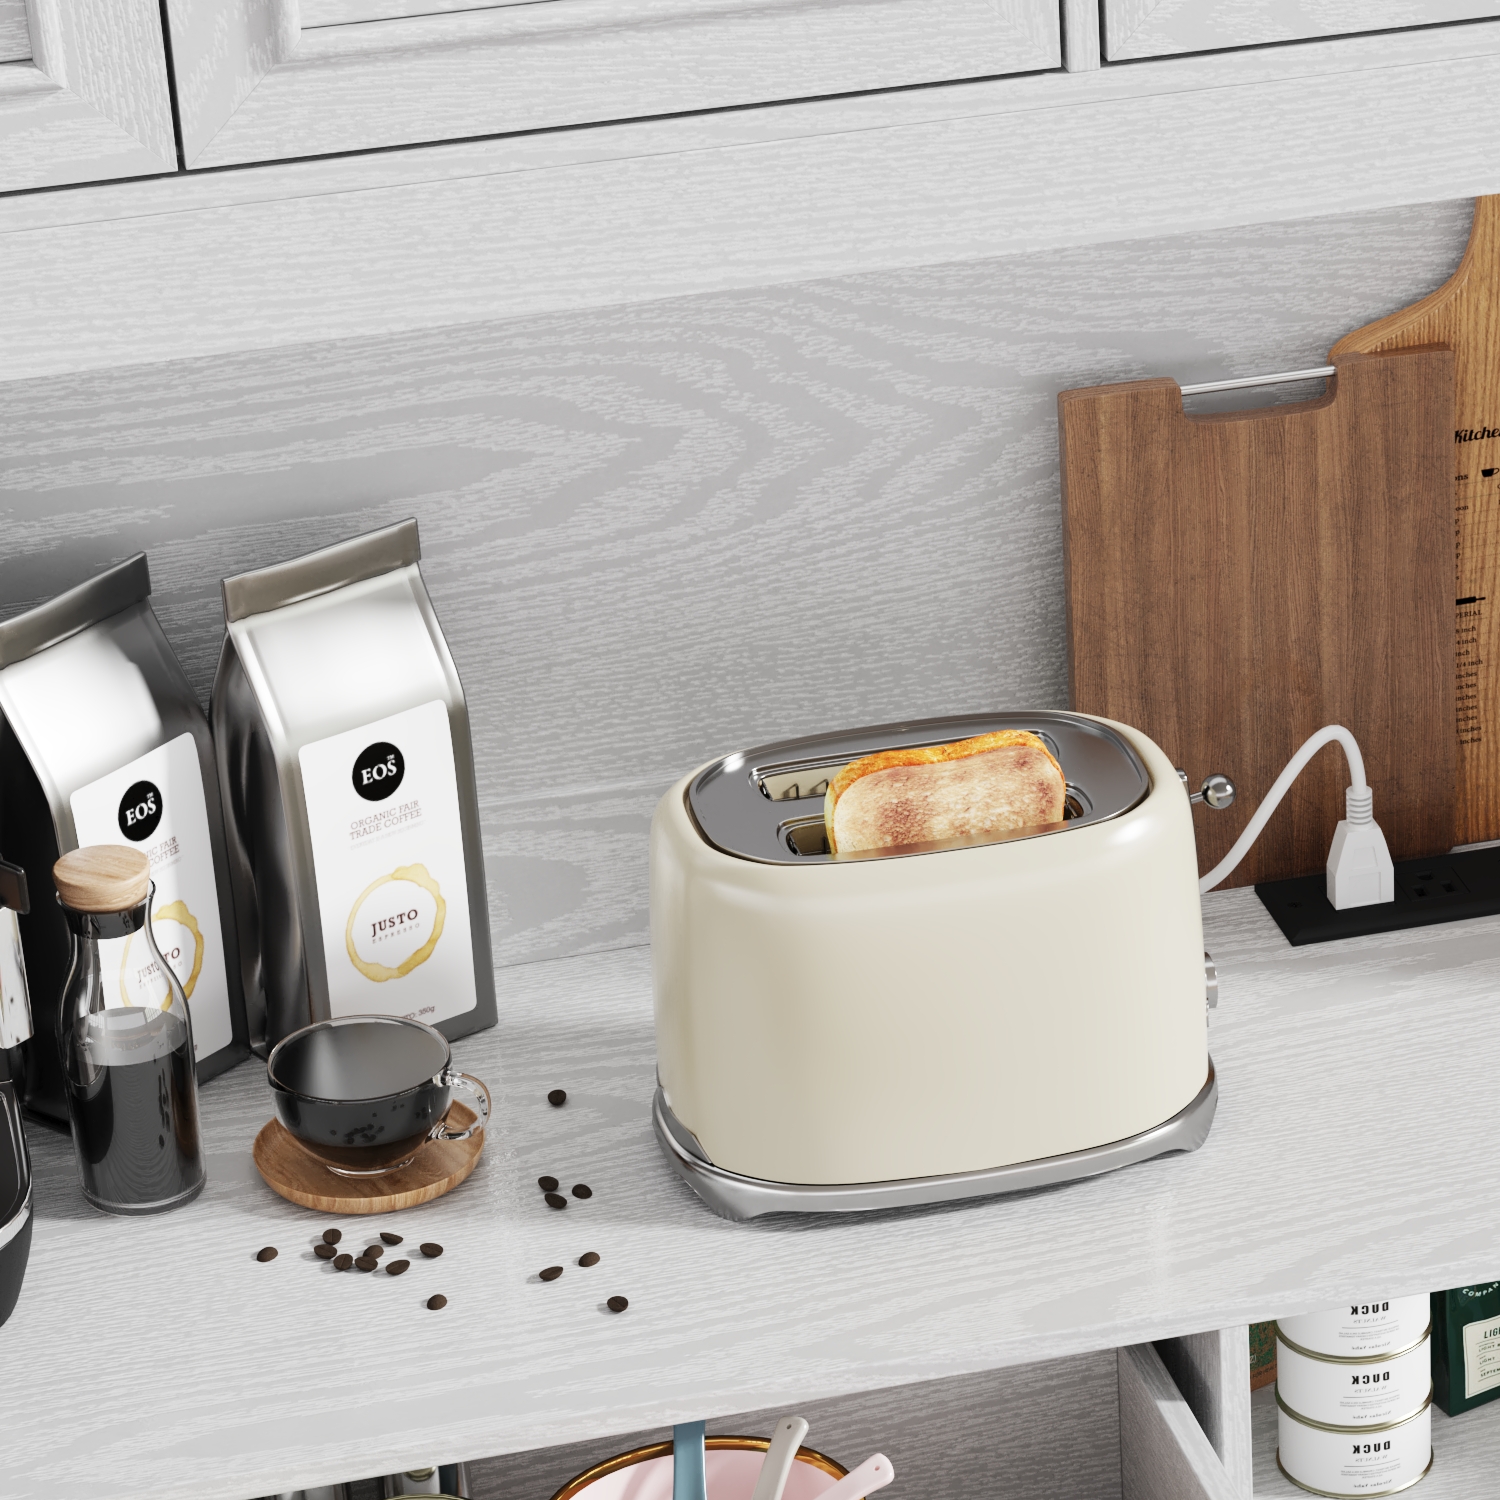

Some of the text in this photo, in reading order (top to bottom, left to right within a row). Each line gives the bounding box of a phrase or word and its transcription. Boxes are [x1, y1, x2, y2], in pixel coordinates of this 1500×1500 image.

[361, 759, 398, 785] EOS
[126, 797, 156, 826] EOS
[349, 823, 382, 840] TRADE
[384, 808, 422, 828] COFFEE
[351, 800, 419, 830] ORGANIC FAIR
[371, 909, 418, 937] JUSTO
[372, 923, 420, 944] ESPRESSO
[1462, 1282, 1499, 1297] COMPAN
[1479, 1357, 1495, 1365] LIGHT
